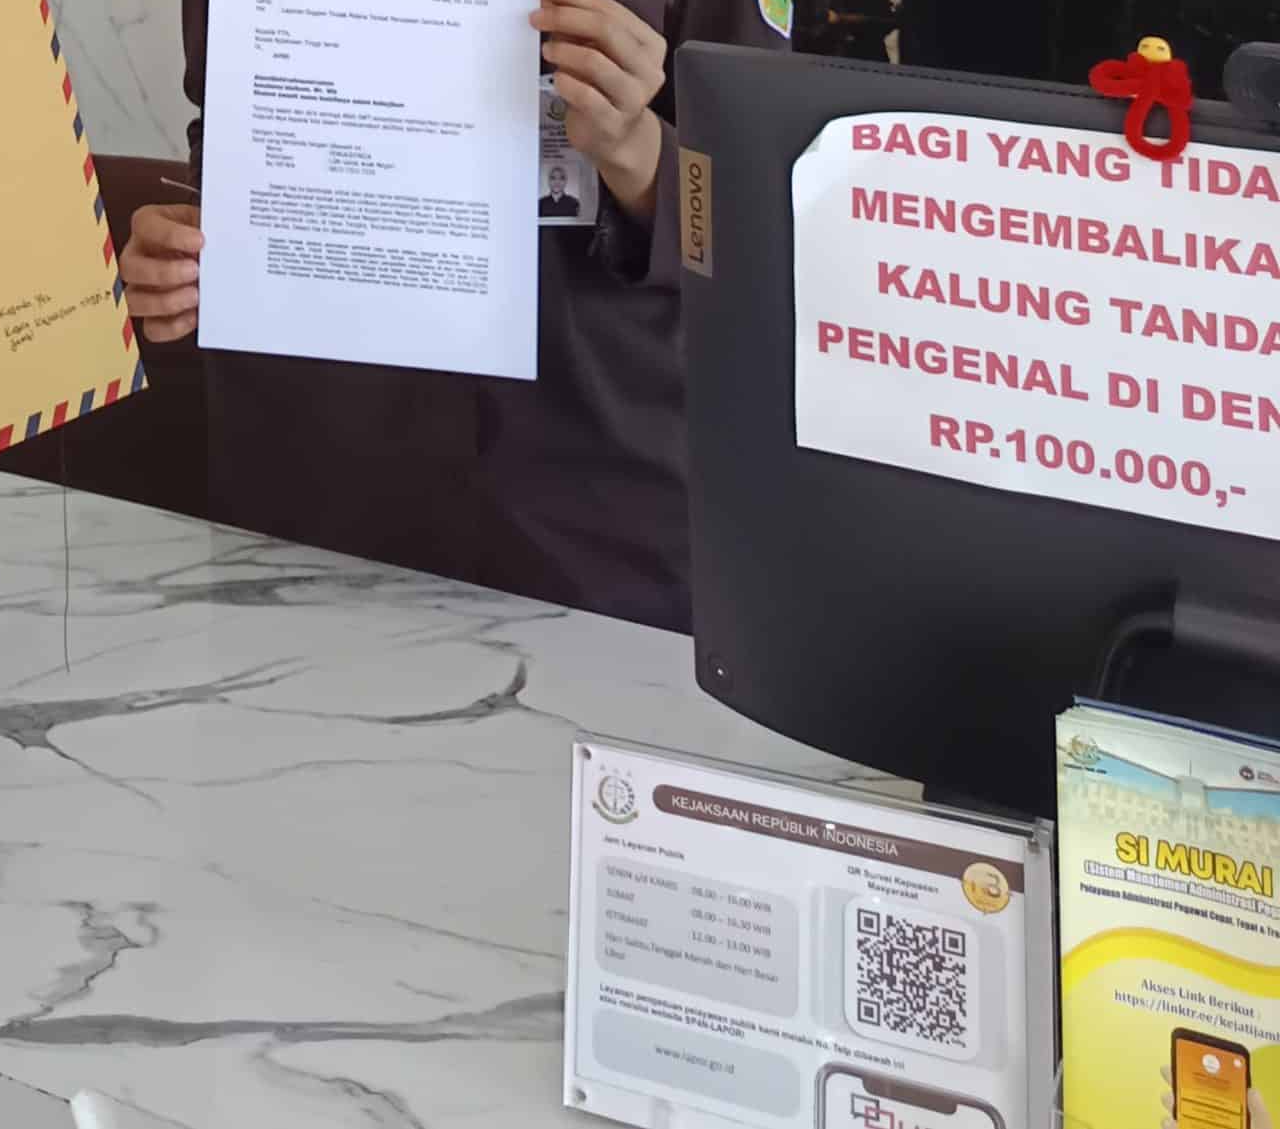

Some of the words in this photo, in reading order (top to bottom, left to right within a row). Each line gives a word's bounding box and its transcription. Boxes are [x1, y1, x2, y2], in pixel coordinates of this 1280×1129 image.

[851, 123, 968, 163] BAGI
[987, 130, 1131, 182] YANG
[690, 162, 705, 265] Lenovo
[851, 187, 1280, 280] MENGEMBALIKA
[877, 261, 1090, 327] KALUNG
[818, 320, 1089, 401] PENGENAL
[1108, 372, 1159, 414] DI
[929, 413, 1247, 509] RP.100.000,-
[671, 795, 750, 824] KEJAKSAAN
[751, 813, 819, 839] REPUBLIK
[822, 827, 899, 858] INDONESIA
[1116, 831, 1150, 866] SI
[1156, 839, 1274, 898] MURAI
[1141, 978, 1176, 997] Akses
[1179, 987, 1209, 1005] Link
[1209, 994, 1255, 1019] Berikut
